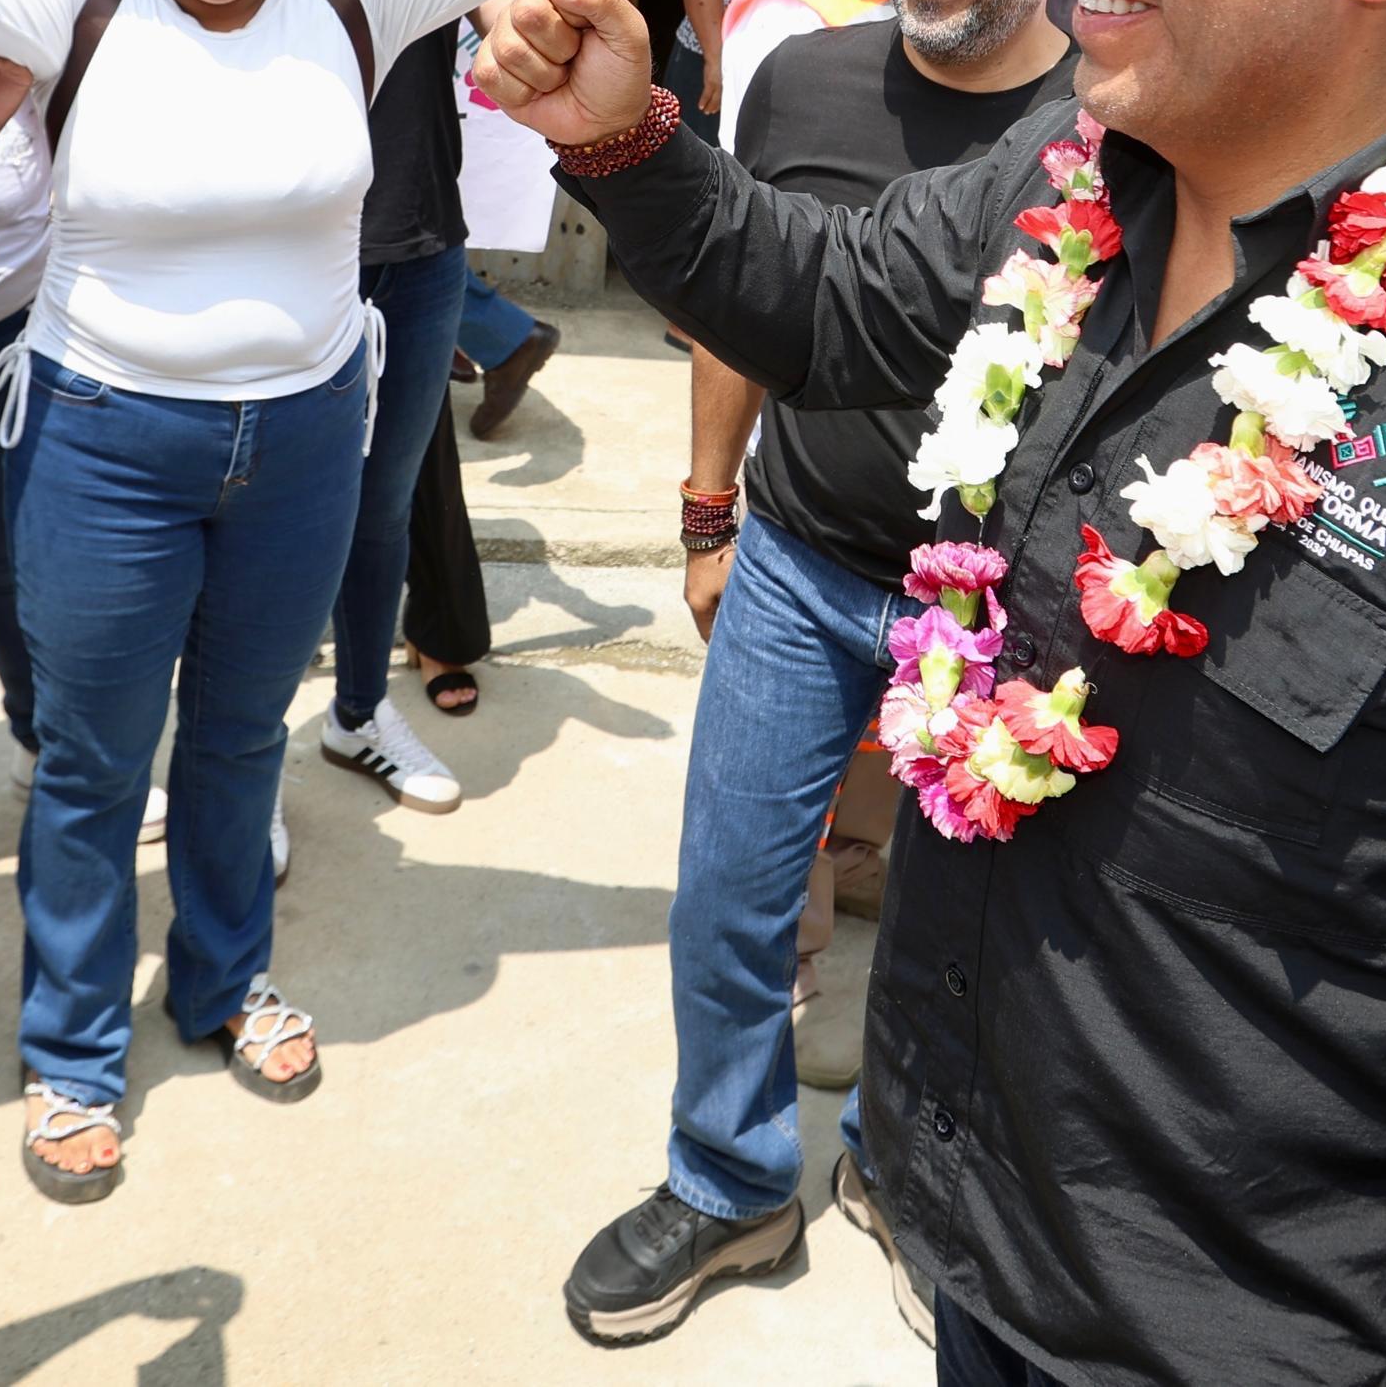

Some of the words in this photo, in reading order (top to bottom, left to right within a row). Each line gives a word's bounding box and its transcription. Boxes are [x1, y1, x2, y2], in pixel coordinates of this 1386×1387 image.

[1293, 452, 1356, 501] ANISMO
[1296, 516, 1316, 534] DE
[1316, 528, 1376, 571] CHIAPAS
[1298, 534, 1327, 558] 2030
